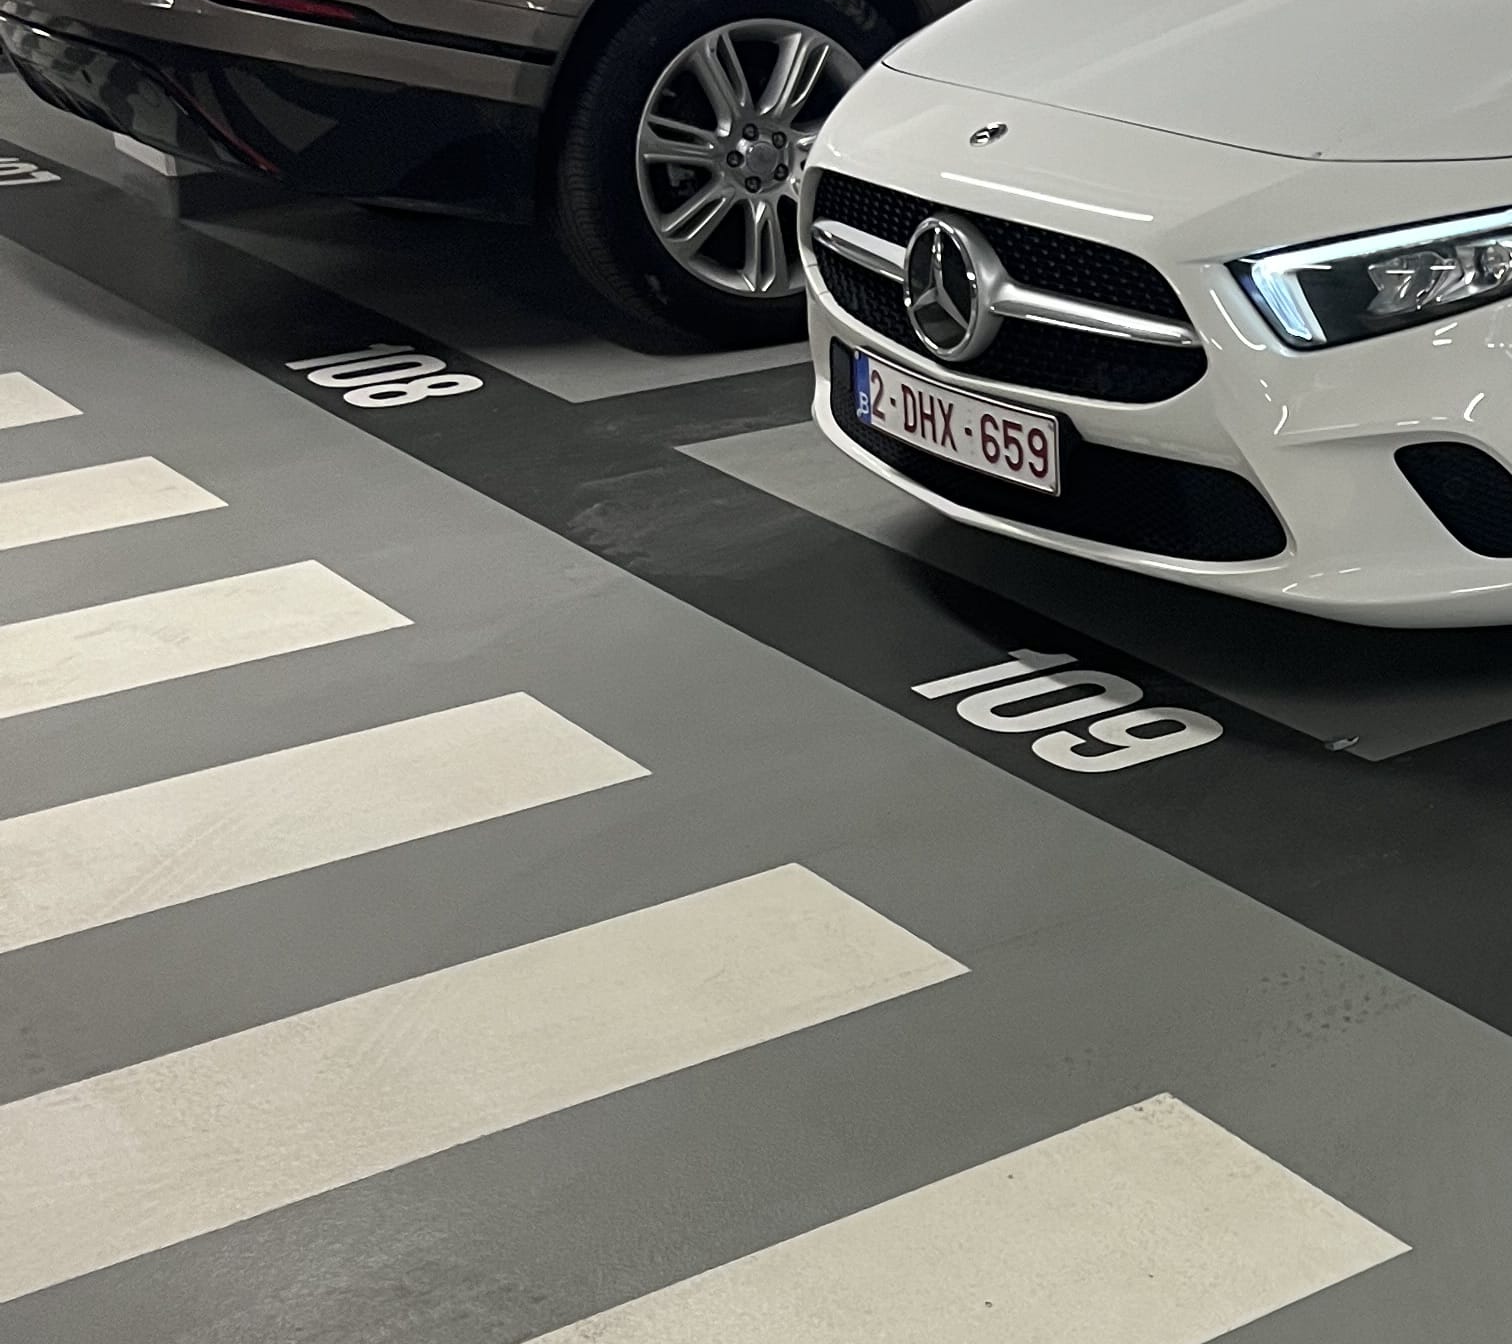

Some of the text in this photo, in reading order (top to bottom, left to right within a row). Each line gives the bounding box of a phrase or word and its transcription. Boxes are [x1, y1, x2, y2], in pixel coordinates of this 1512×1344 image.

[285, 343, 483, 408] 108
[871, 369, 1049, 479] 2-DHX-659
[911, 649, 1223, 772] 109
